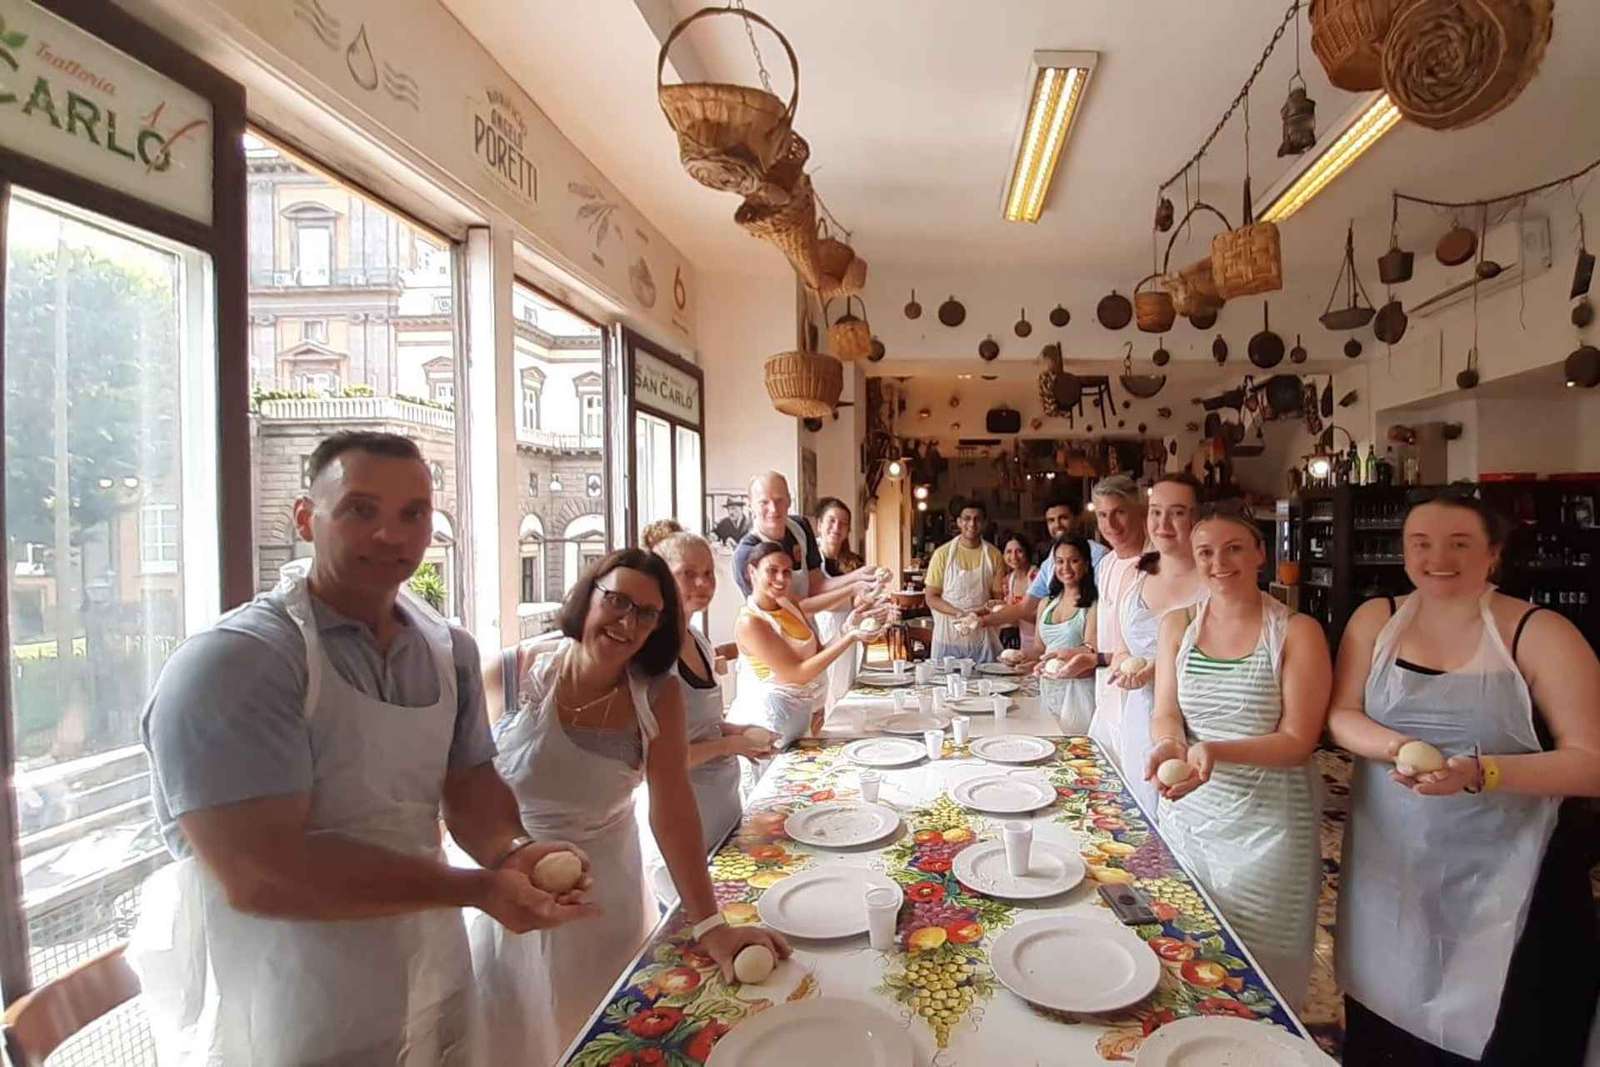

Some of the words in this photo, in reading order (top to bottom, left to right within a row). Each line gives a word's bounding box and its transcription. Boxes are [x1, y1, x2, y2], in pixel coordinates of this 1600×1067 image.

[36, 42, 116, 95] Trattoria
[474, 113, 538, 204] PORETTI
[673, 266, 686, 310] 6
[634, 372, 658, 396] SAN
[659, 381, 694, 410] CARLO
